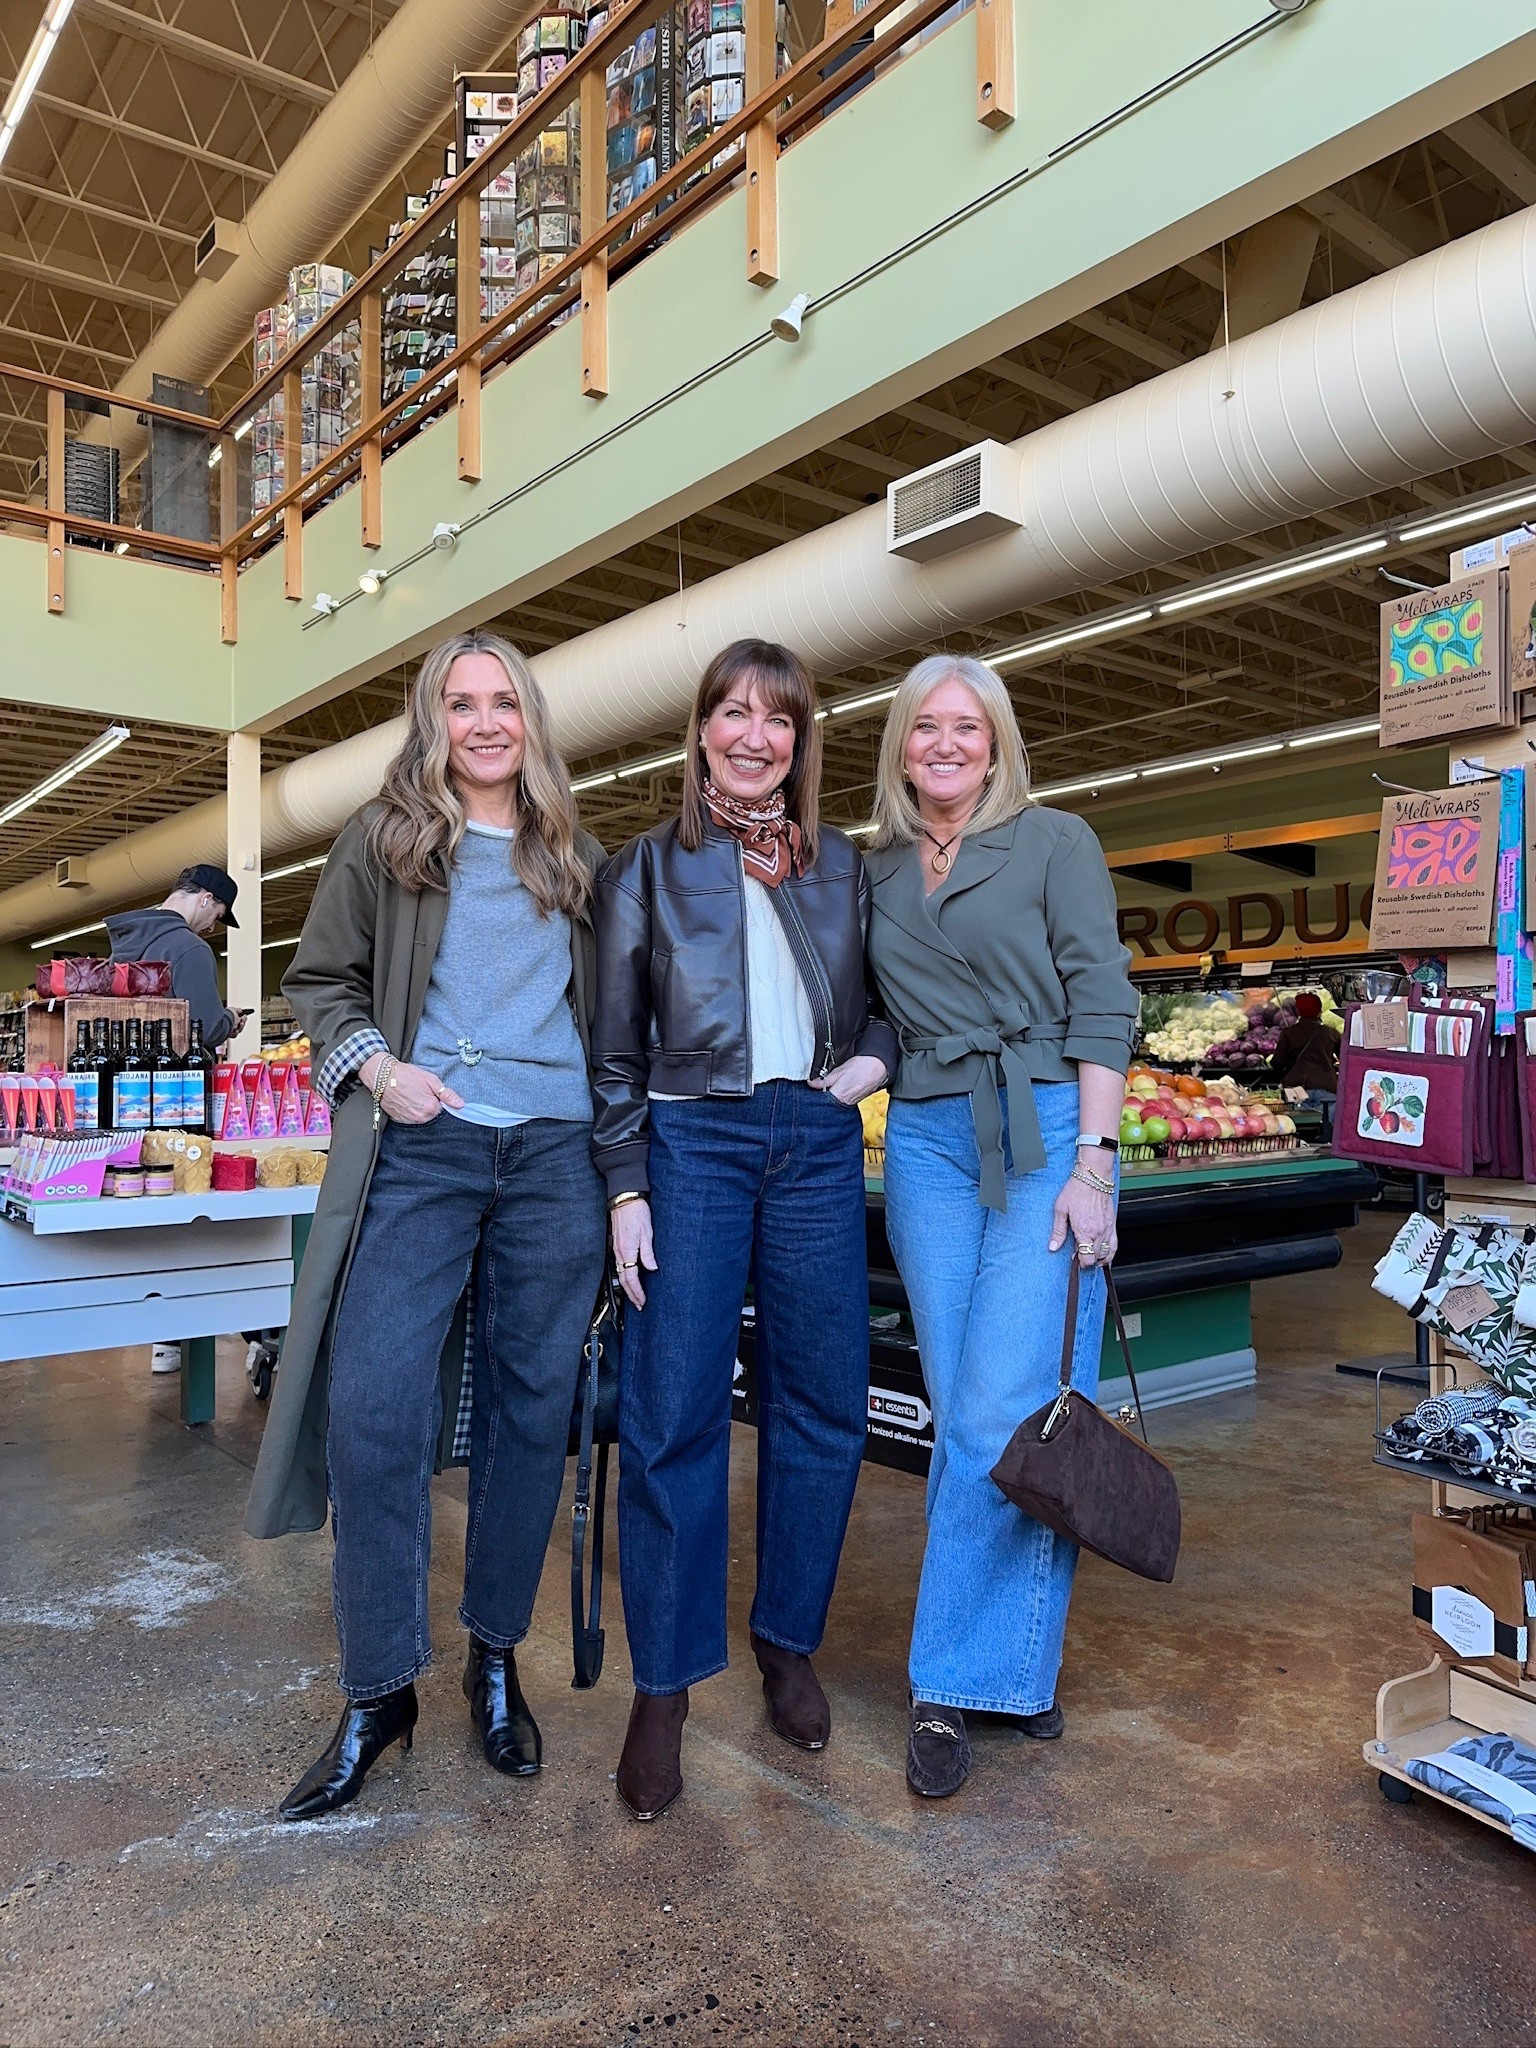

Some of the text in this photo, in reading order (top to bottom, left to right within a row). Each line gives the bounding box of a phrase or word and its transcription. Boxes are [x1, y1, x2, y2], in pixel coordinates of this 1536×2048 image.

[661, 78, 671, 177] NATURAL ELEMENT
[1471, 579, 1485, 587] PACK
[1398, 589, 1473, 621] Meli WRAPS
[1383, 669, 1491, 701] Reusable Swedish Dishcloths
[1464, 685, 1486, 695] natural
[1437, 712, 1455, 721] CLEAN
[1476, 703, 1496, 713] REPEAT
[1395, 799, 1480, 822] Meli WRAPS
[1377, 889, 1485, 903] Reusable Swedish Dishcloths
[1117, 882, 1374, 957] RODU
[1381, 1009, 1389, 1025] GIFT
[119, 1072, 149, 1080] RIOJANA
[1447, 1299, 1465, 1311] GIFT
[1464, 1288, 1478, 1301] SET
[885, 1402, 916, 1418] essentia
[871, 1424, 894, 1438] ionized
[893, 1432, 918, 1445] alkaline
[918, 1438, 935, 1449] wate
[1444, 1609, 1481, 1630] HEIRLOOM
